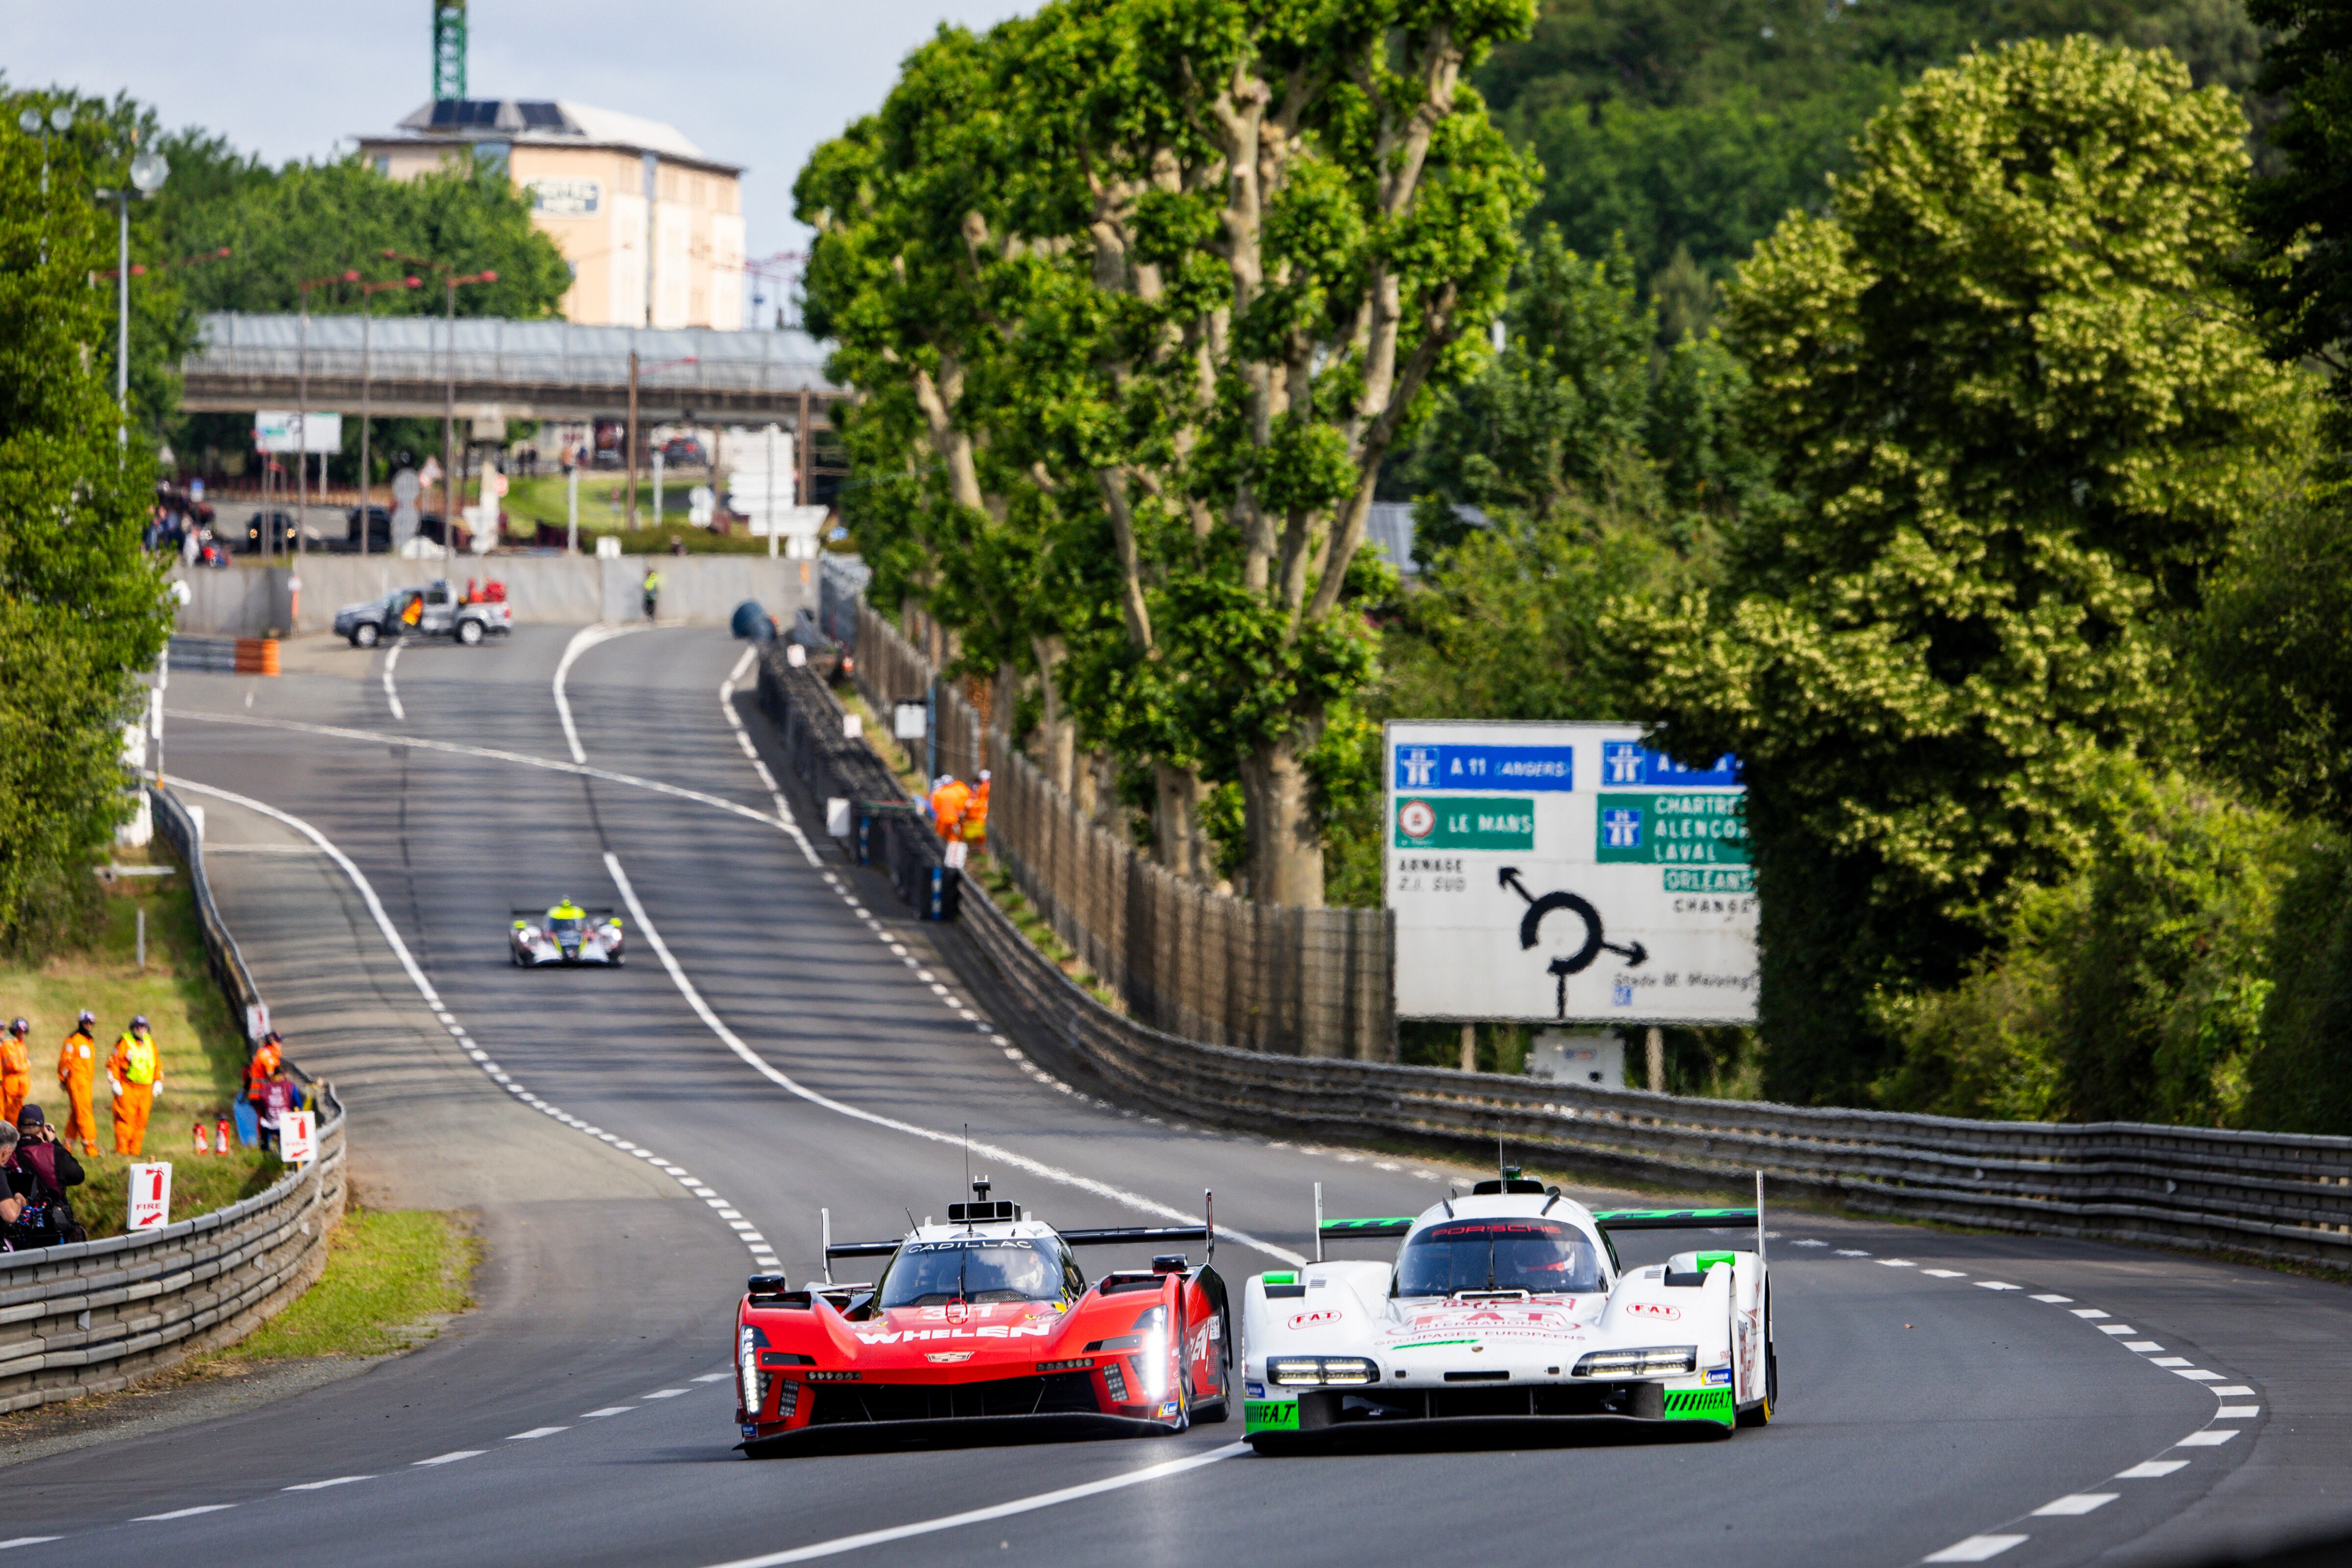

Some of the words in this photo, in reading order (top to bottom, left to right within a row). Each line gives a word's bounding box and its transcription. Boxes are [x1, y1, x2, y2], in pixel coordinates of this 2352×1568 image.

[1450, 757, 1464, 776] A
[1468, 757, 1487, 776] 11
[1448, 813, 1470, 833] LE
[1478, 813, 1533, 834] MANS
[1654, 843, 1716, 862] LAVAL
[1432, 877, 1467, 892] SUD
[1431, 1224, 1563, 1238] PORSCHE
[908, 1241, 1032, 1253] CADILLAC
[854, 1323, 1051, 1345] WHELEN
[1374, 1331, 1477, 1346] GROUPAGES
[1484, 1331, 1586, 1341] EUROPEENS
